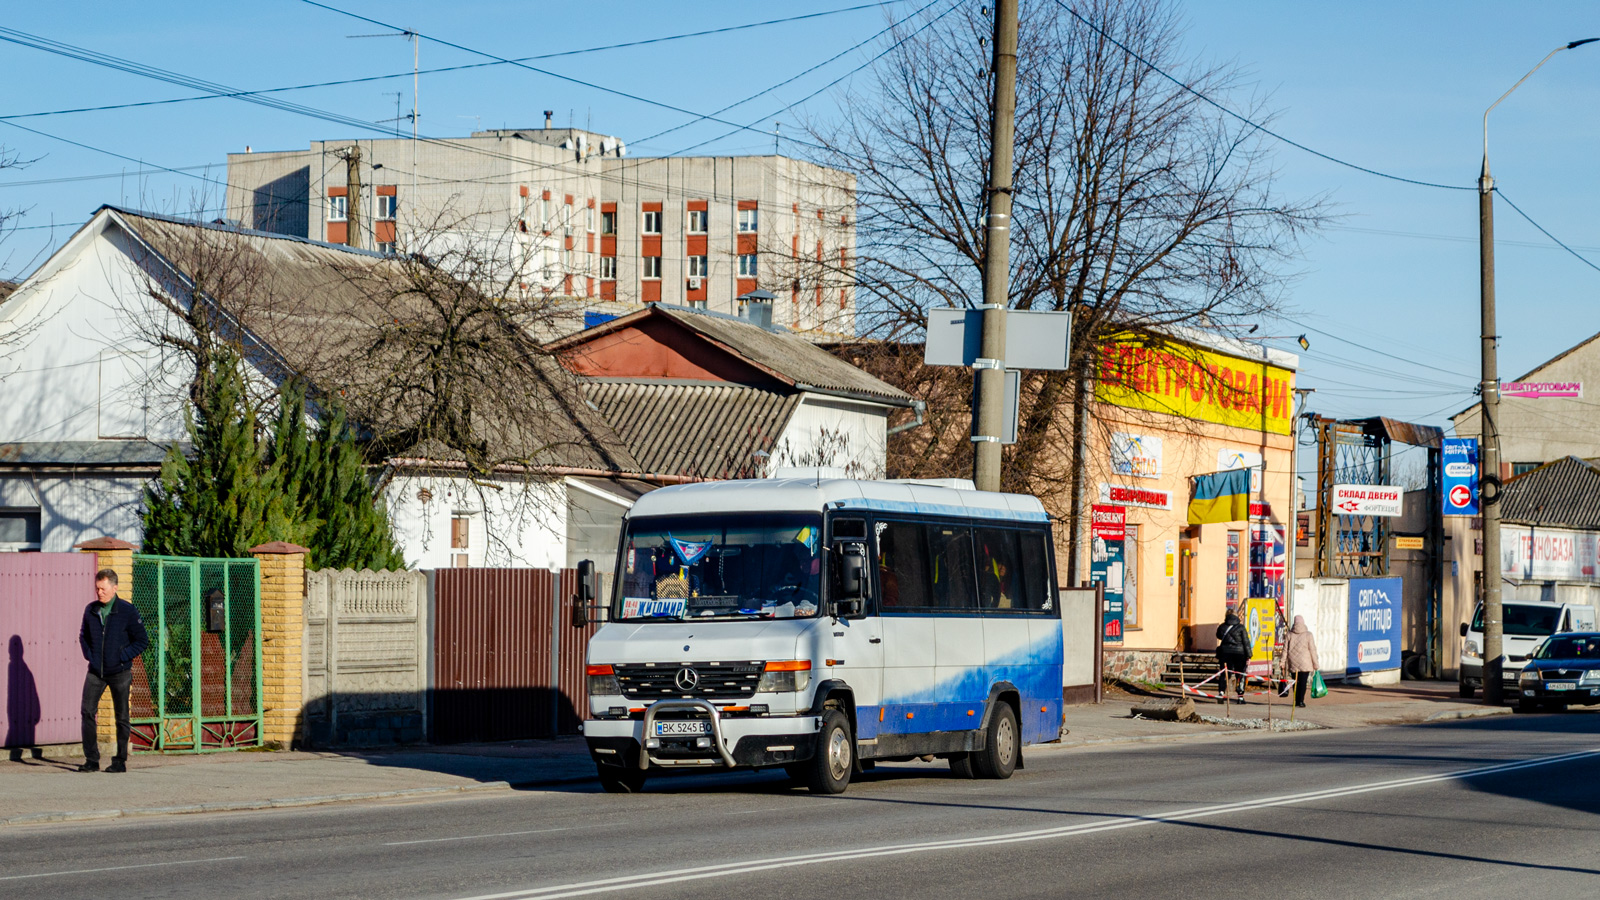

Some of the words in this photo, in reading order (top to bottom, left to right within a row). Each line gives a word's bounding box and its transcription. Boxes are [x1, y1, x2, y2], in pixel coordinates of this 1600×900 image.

[1101, 342, 1288, 419] ЕЛЕКТРОТОВАРИ
[1501, 382, 1580, 391] ЕЛЕКТРОТОВАРИ
[1338, 490, 1366, 500] СКЛАД
[1368, 491, 1398, 501] ДВЕРЕЙ
[1364, 505, 1395, 513] ФОРТЕЦЯ
[1358, 589, 1374, 607] СВІТ
[637, 601, 683, 616] ЖИТОМИР
[1358, 608, 1392, 634] МАТРАЦІВ
[663, 721, 675, 733] BK
[677, 721, 697, 733] 5245
[699, 722, 712, 733] BO
